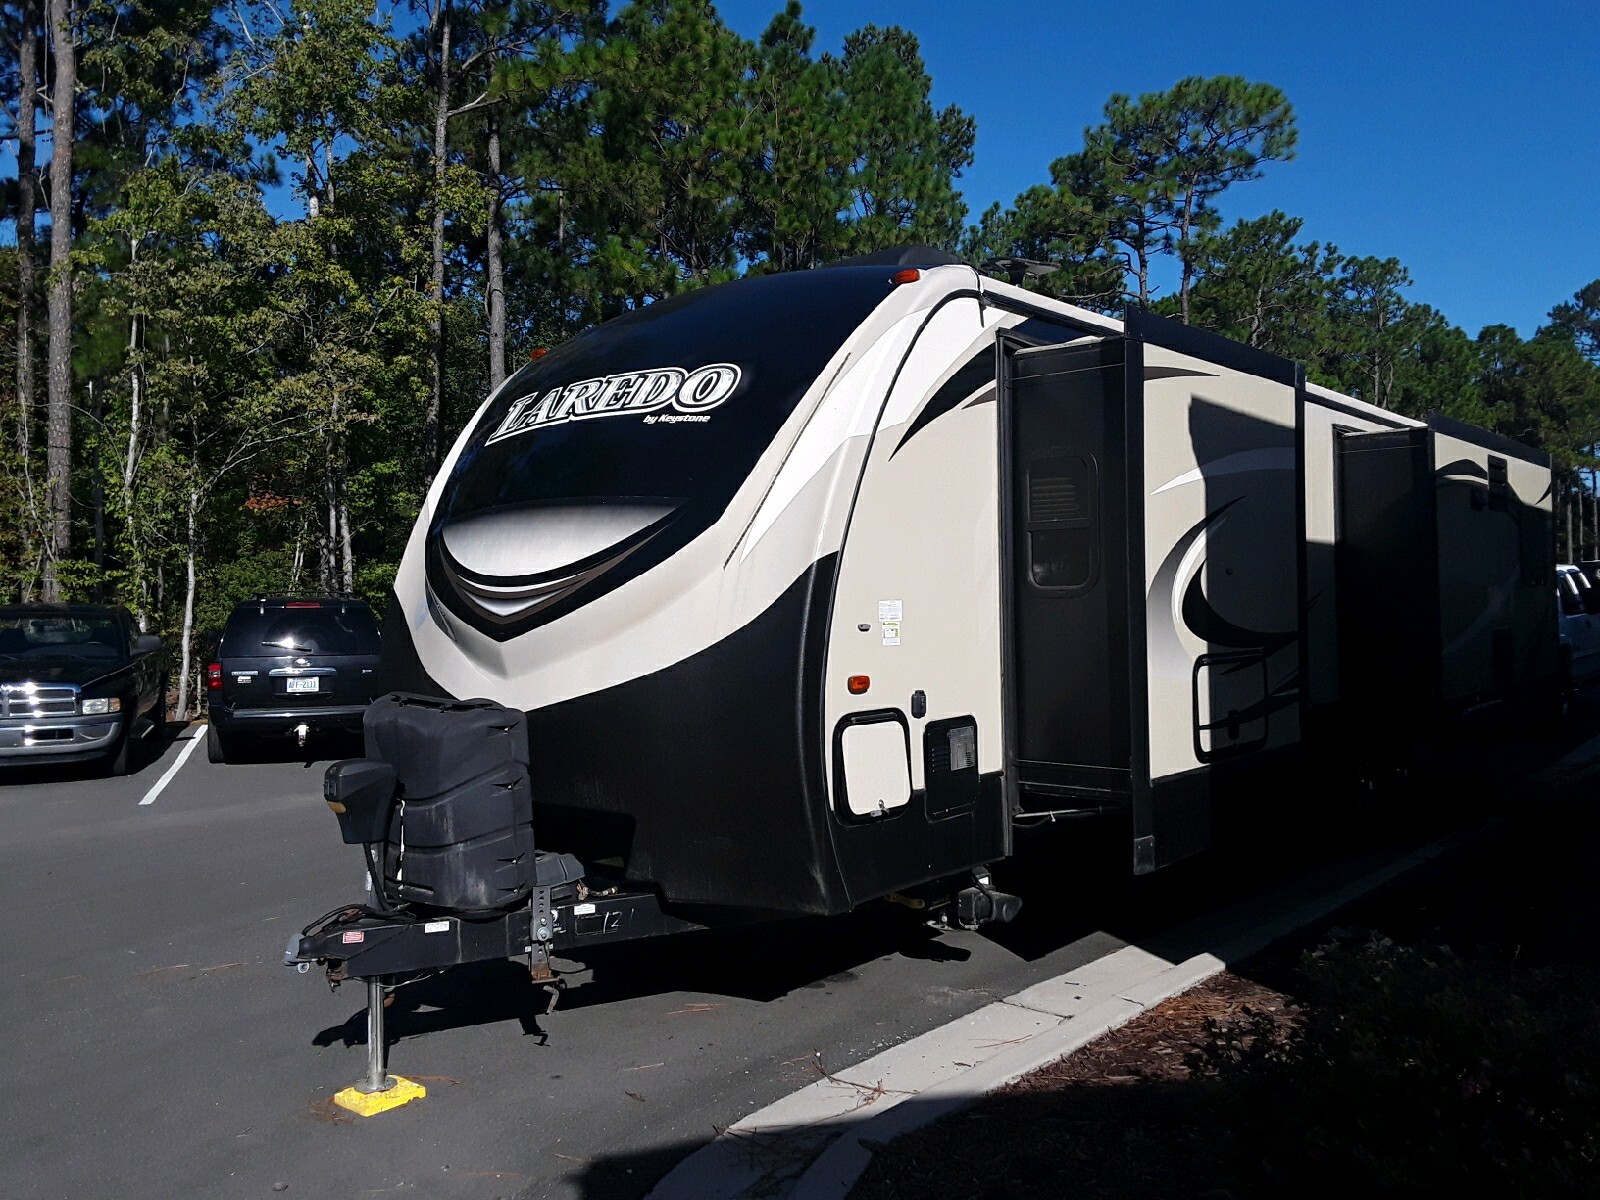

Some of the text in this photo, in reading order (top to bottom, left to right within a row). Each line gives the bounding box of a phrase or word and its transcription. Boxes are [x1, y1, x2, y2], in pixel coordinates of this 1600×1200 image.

[484, 363, 742, 446] LAREDO
[643, 414, 711, 425] by Keystone
